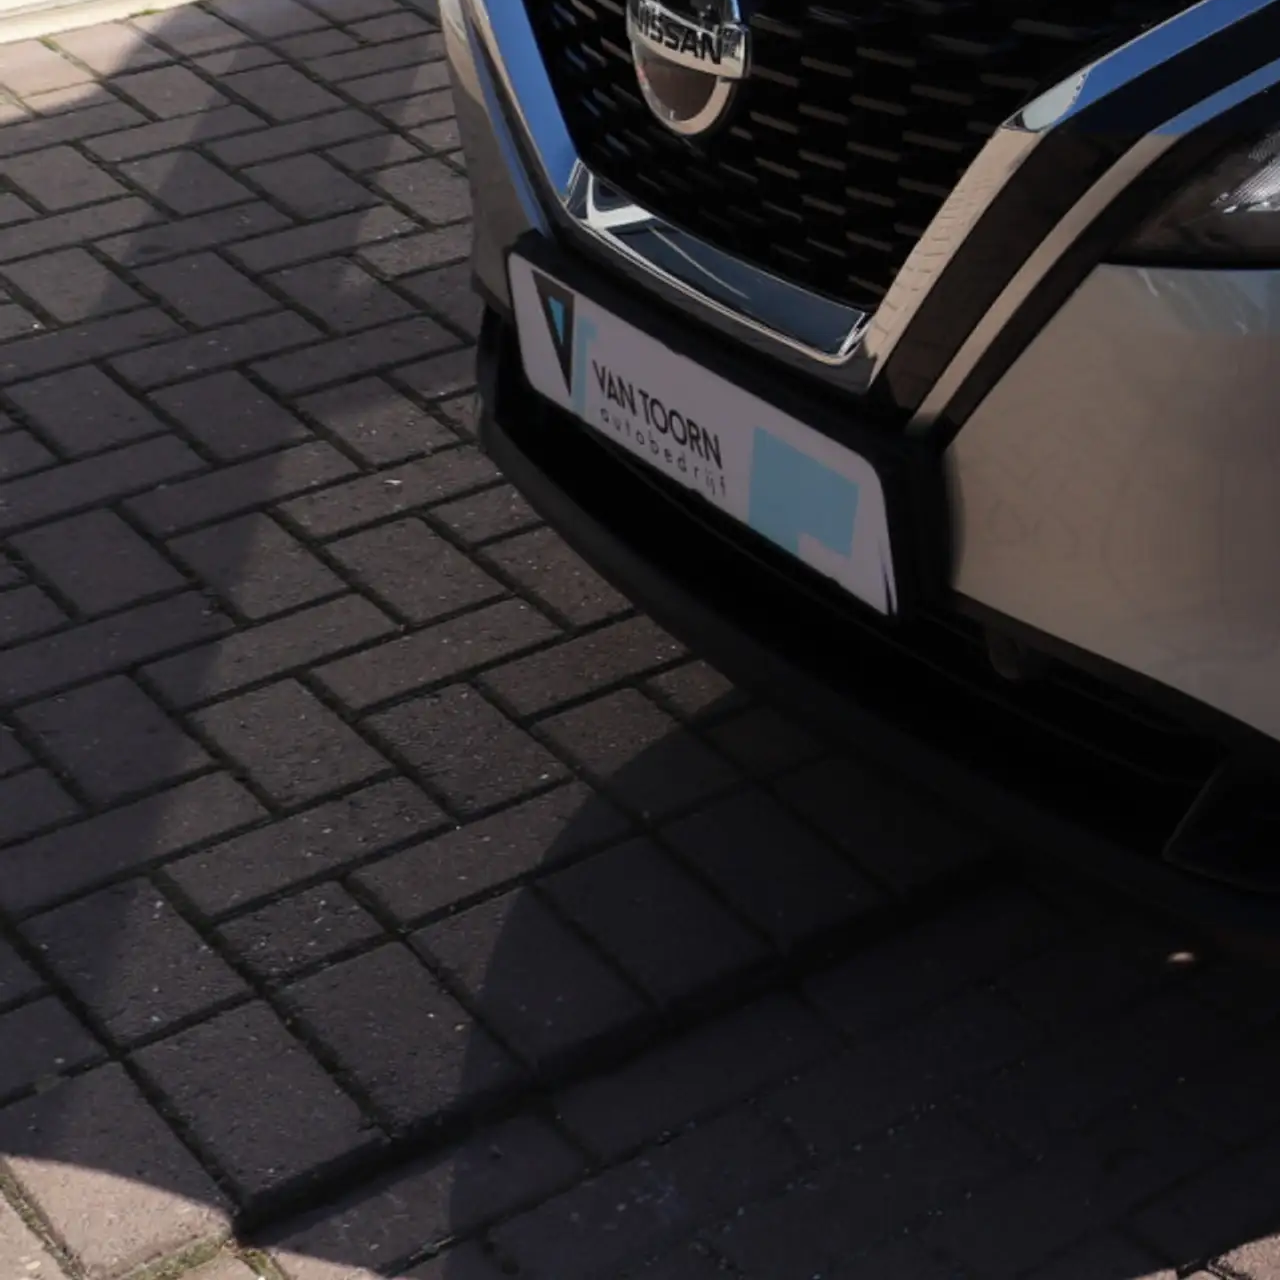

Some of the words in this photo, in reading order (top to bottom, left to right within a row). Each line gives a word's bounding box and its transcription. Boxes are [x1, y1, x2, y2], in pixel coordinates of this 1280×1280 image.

[592, 359, 636, 416] VAN
[638, 389, 723, 470] TOORN
[600, 408, 726, 497] autobedrijf
